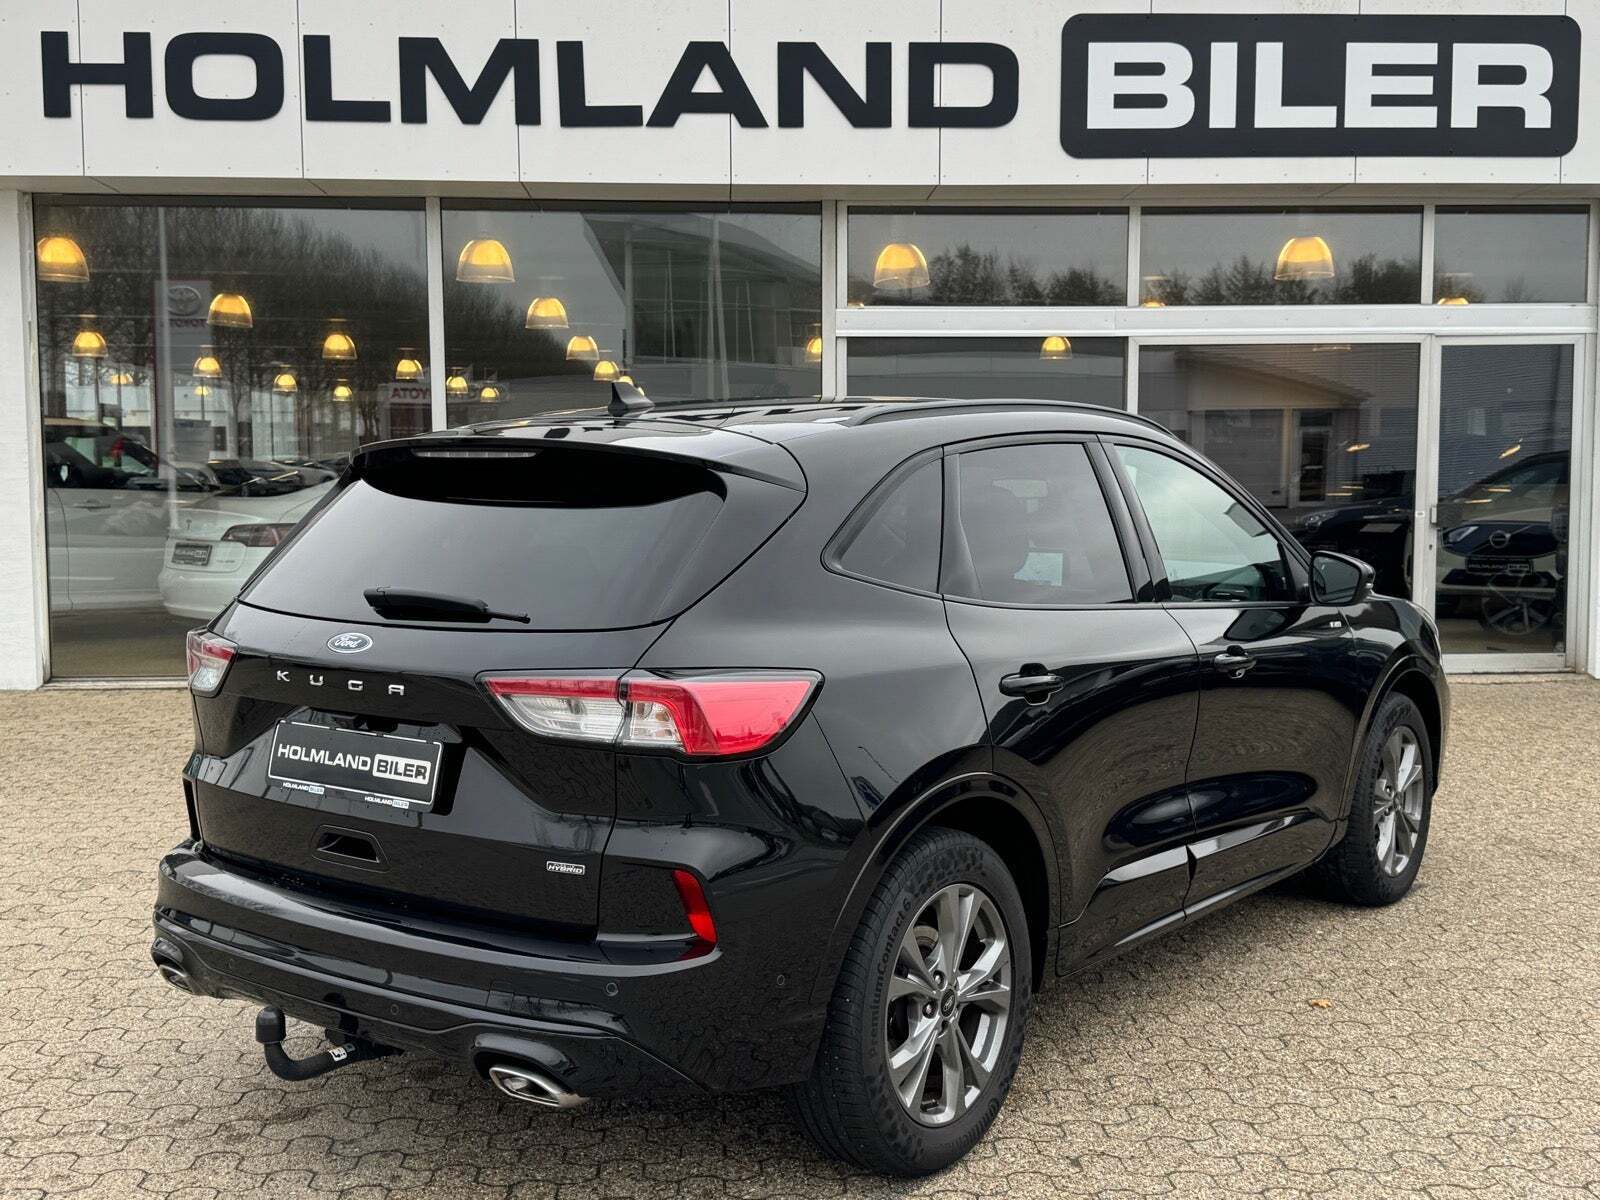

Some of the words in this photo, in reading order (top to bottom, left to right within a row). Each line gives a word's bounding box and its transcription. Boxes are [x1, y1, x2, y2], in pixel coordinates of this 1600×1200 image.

[40, 31, 1020, 128] HOLMLAND
[1086, 42, 1554, 130] BILER
[276, 670, 405, 696] KUGA
[277, 743, 371, 771] HOLMLAND
[376, 759, 428, 780] BILER
[282, 782, 309, 791] HOLMLAND
[365, 796, 392, 805] HOLMLAND
[548, 864, 583, 874] HYBRID
